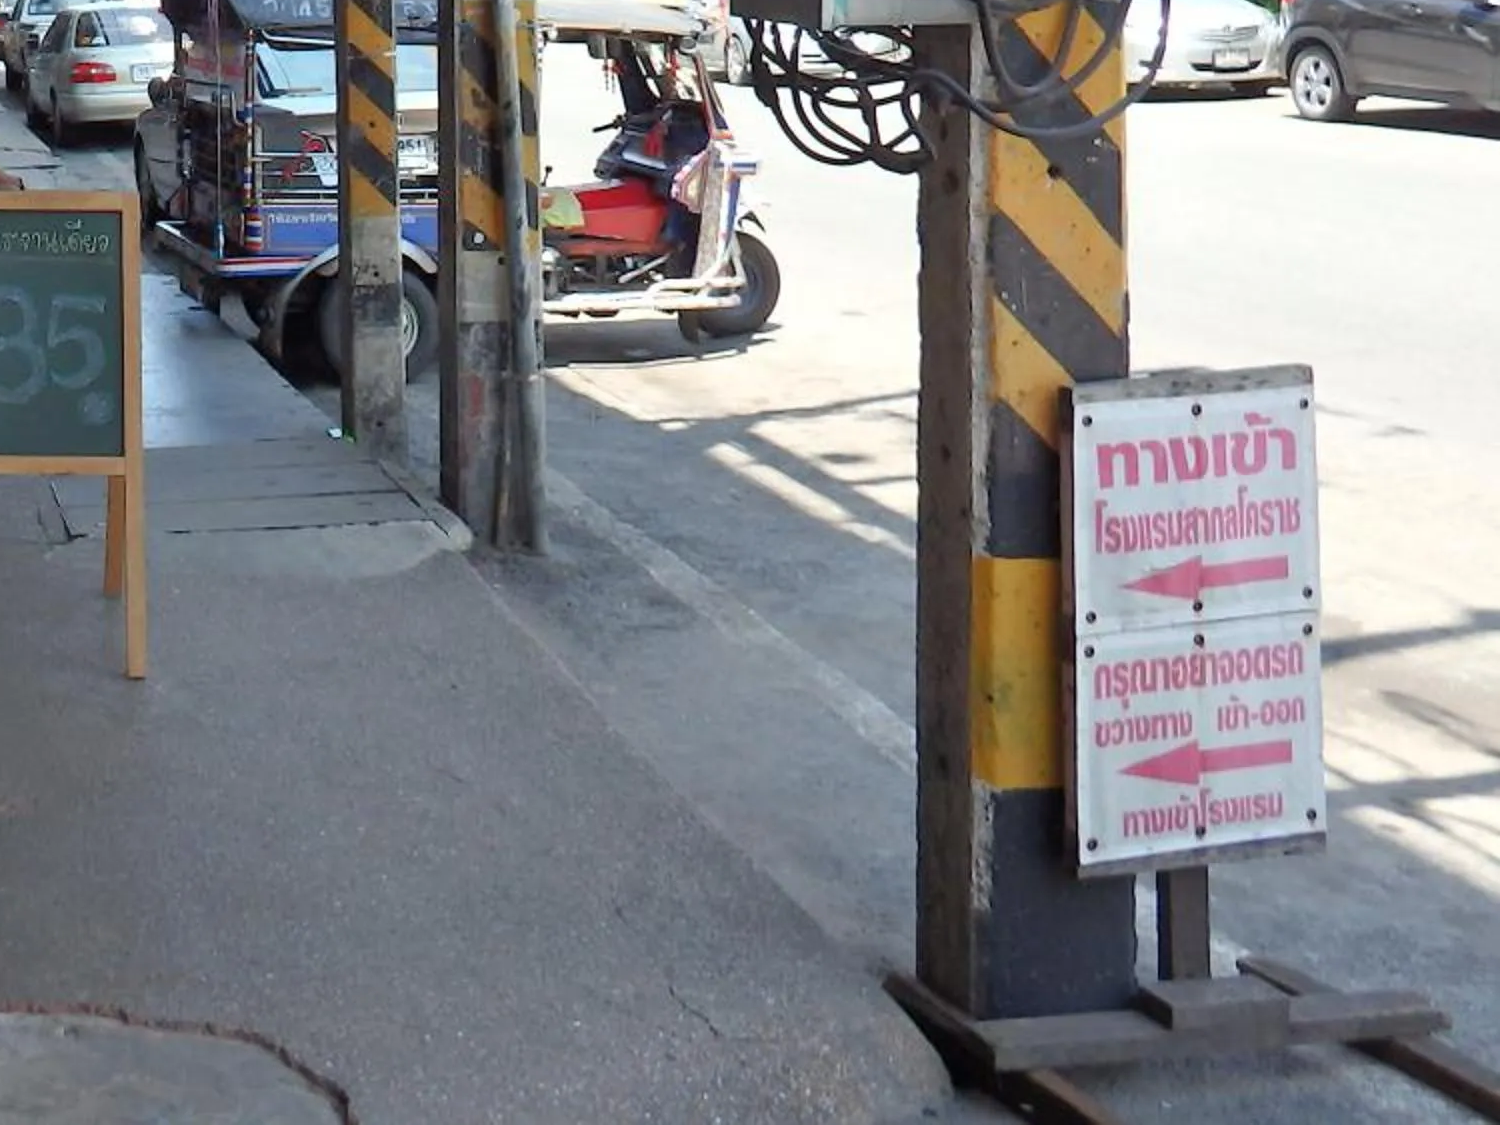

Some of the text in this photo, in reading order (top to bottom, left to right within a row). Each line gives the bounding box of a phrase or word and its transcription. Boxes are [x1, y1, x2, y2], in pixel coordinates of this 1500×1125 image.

[1096, 412, 1297, 489] ทางเข้า
[1095, 486, 1300, 554] โรงแรมสากลโคราช
[1095, 694, 1306, 747] ขวางทาง เข้า-ออก
[1122, 787, 1284, 838] ทางเข้าโรงแรม
